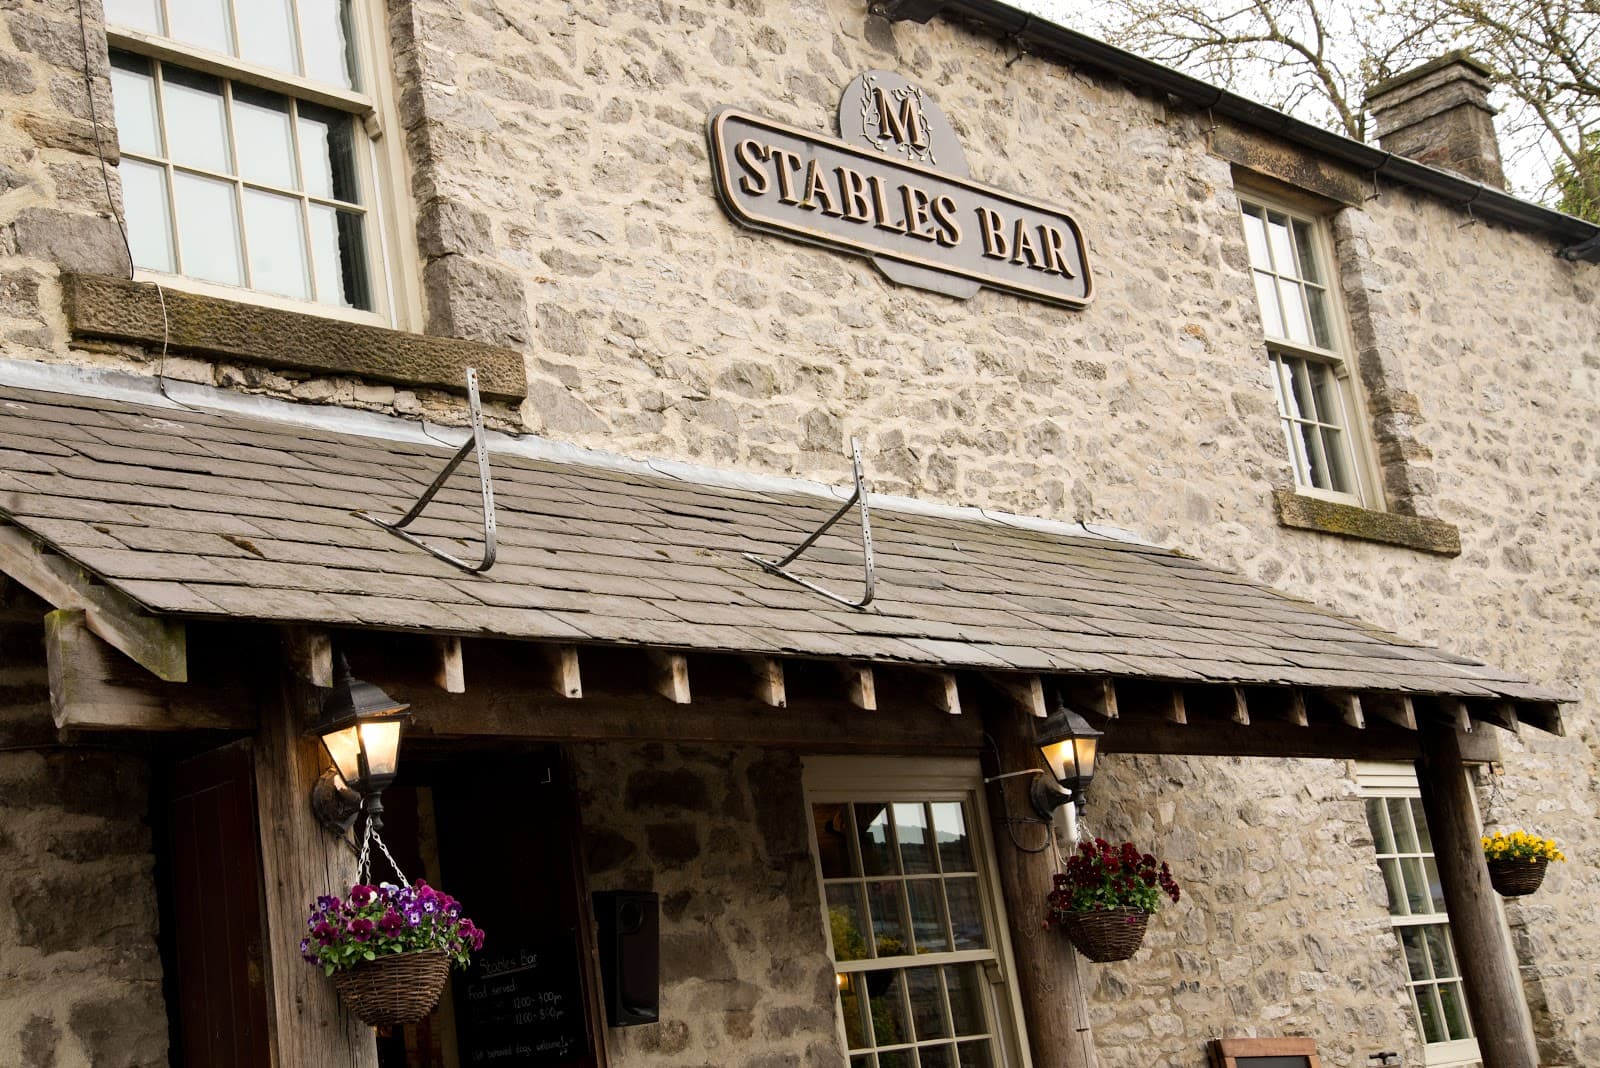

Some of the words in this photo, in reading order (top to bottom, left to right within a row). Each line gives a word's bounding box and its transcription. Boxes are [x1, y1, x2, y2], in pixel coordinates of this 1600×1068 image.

[873, 87, 926, 149] M
[735, 139, 962, 247] STABLES
[976, 206, 1076, 279] BAR
[479, 954, 517, 974] Stables
[520, 948, 538, 965] Bar
[467, 984, 488, 1000] Food
